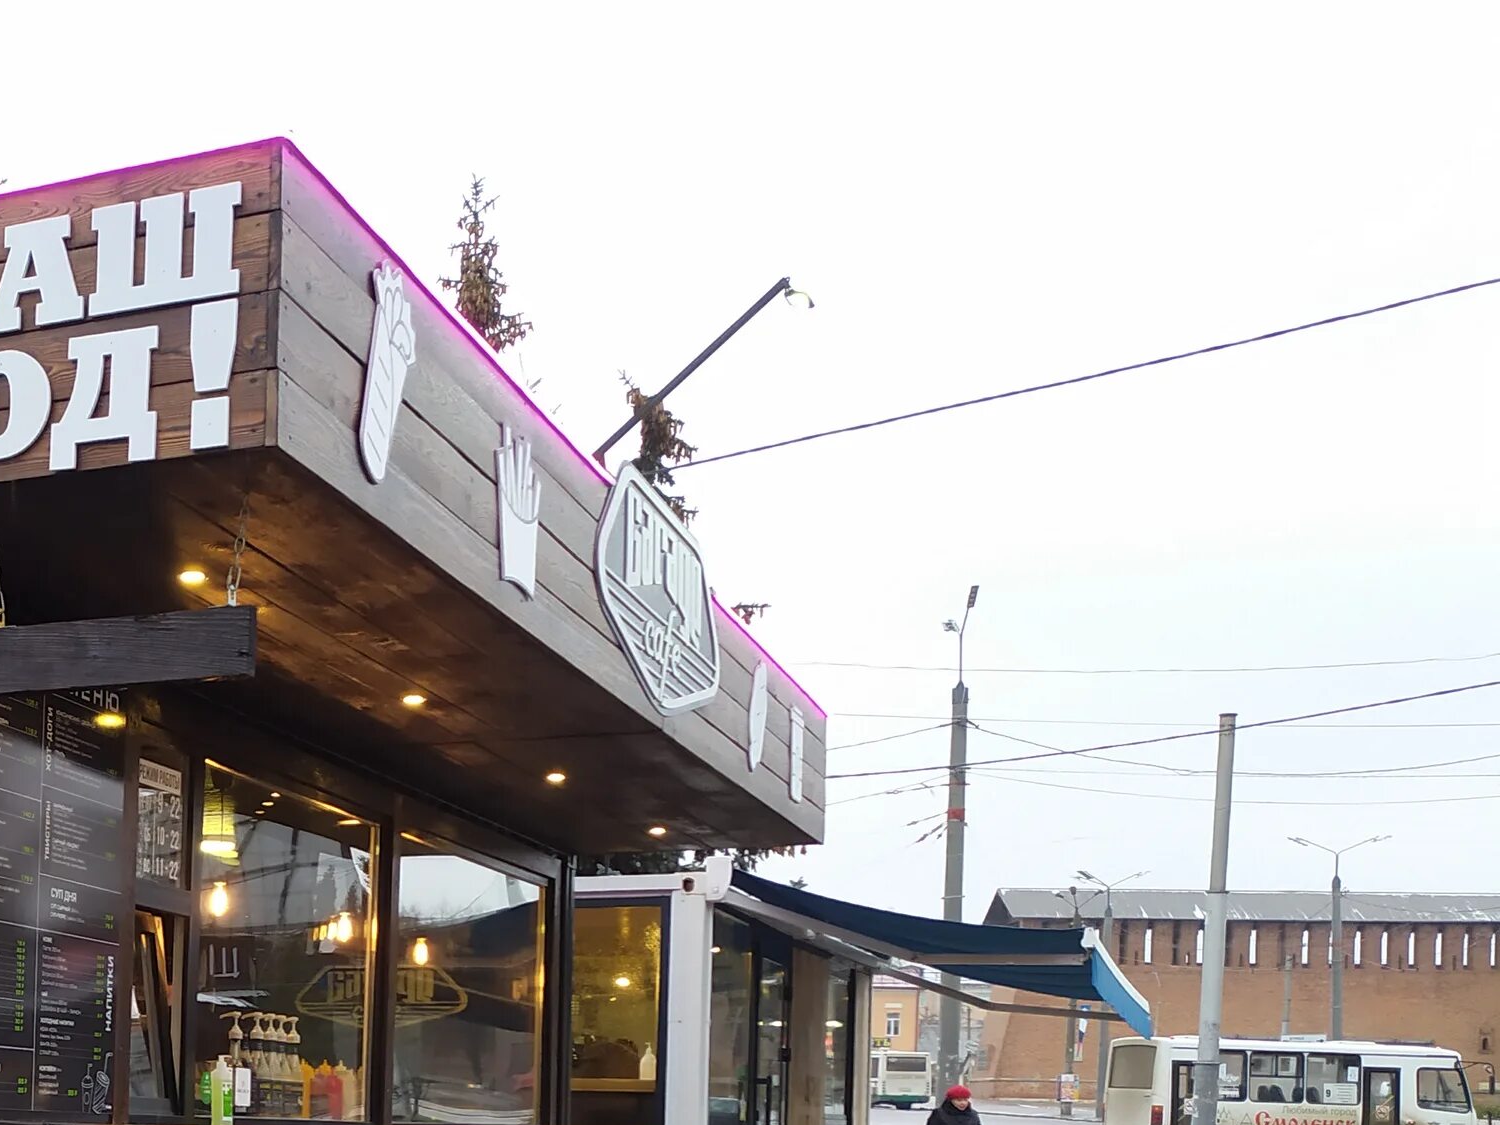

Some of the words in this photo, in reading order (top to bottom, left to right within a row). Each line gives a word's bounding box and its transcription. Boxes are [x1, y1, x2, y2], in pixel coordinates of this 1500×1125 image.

[643, 609, 682, 701] cafe
[69, 689, 120, 714] ЕНЮ
[45, 706, 54, 772] ХОТ-ДОГИ
[43, 800, 51, 861] ТВИСТЕРЫ
[50, 887, 64, 901] СУП
[105, 955, 115, 1032] НАПИТКИ
[1325, 1088, 1332, 1098] 9
[1330, 1108, 1357, 1117] город
